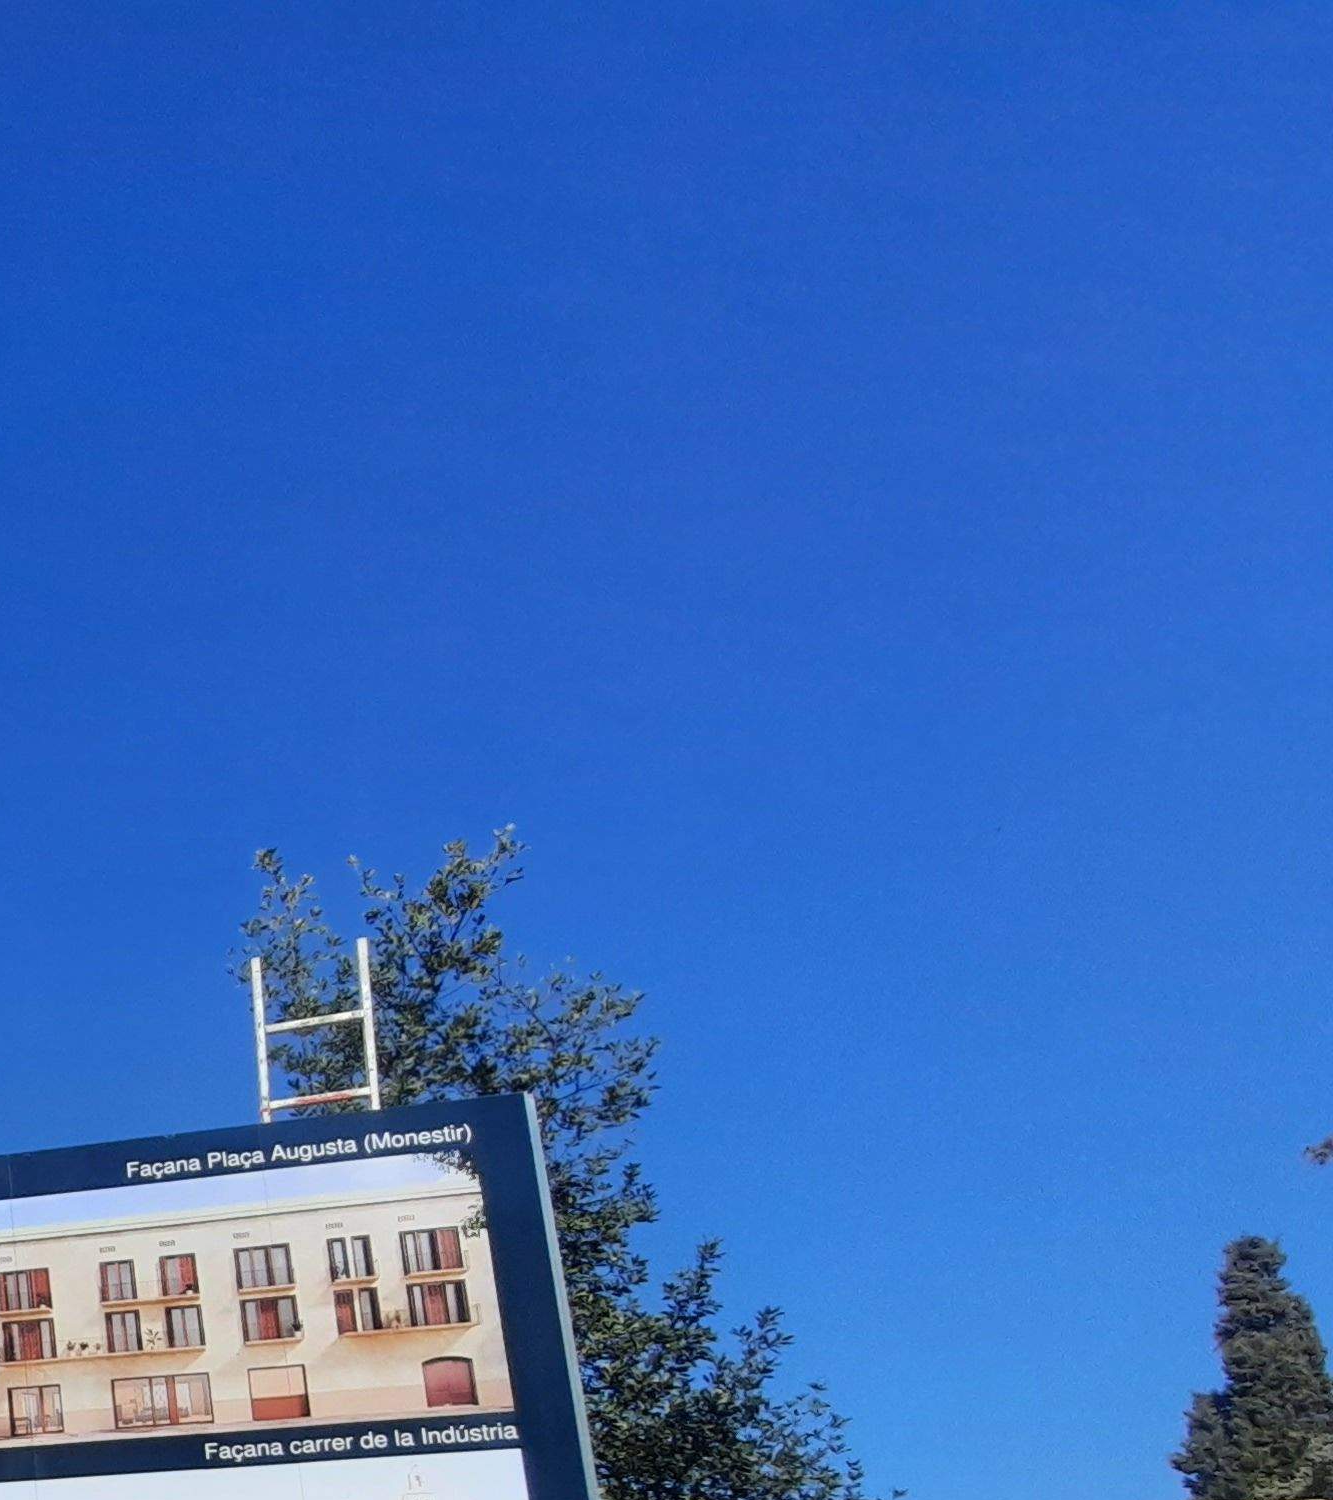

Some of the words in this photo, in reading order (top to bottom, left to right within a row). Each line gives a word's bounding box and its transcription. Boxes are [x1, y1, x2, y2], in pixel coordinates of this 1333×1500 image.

[126, 1157, 201, 1179] Façana
[207, 1150, 265, 1169] Plaça
[271, 1138, 358, 1162] Augusta
[364, 1123, 472, 1154] (Monestir)
[204, 1441, 284, 1462] Façana
[289, 1436, 353, 1454] carrer
[360, 1431, 388, 1449] de
[394, 1429, 415, 1446] la
[421, 1422, 519, 1444] Indústria
